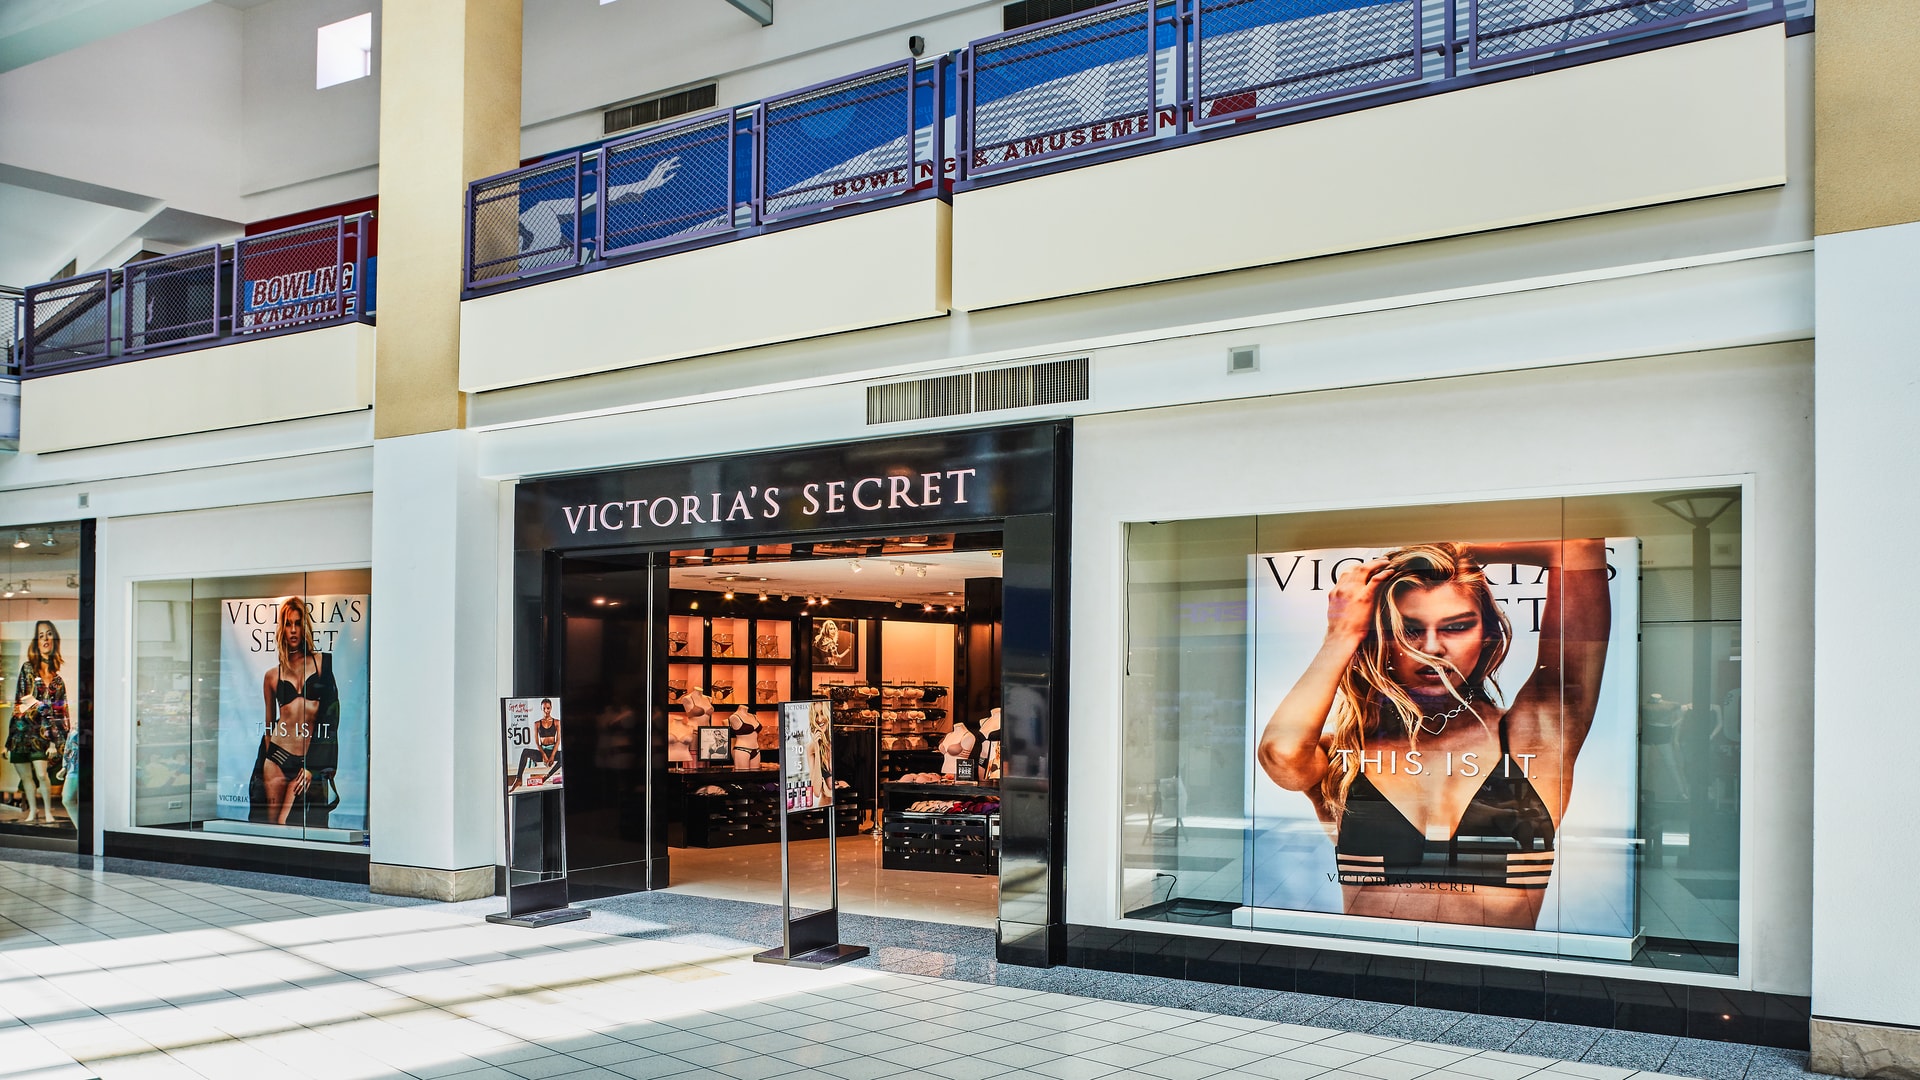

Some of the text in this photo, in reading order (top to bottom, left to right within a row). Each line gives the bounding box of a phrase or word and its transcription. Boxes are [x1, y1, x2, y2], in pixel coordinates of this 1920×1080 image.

[833, 157, 956, 196] BOWLNG
[252, 262, 354, 308] BOWLING
[562, 468, 977, 535] VICTORIA'S SECRET
[226, 599, 362, 625] VICTRIA'S
[250, 628, 339, 653] SEET
[256, 722, 330, 739] THIS. IS. IT.
[508, 727, 531, 745] $50
[1336, 749, 1538, 779] THIS. IS. IT.
[1419, 879, 1477, 893] SECRET
